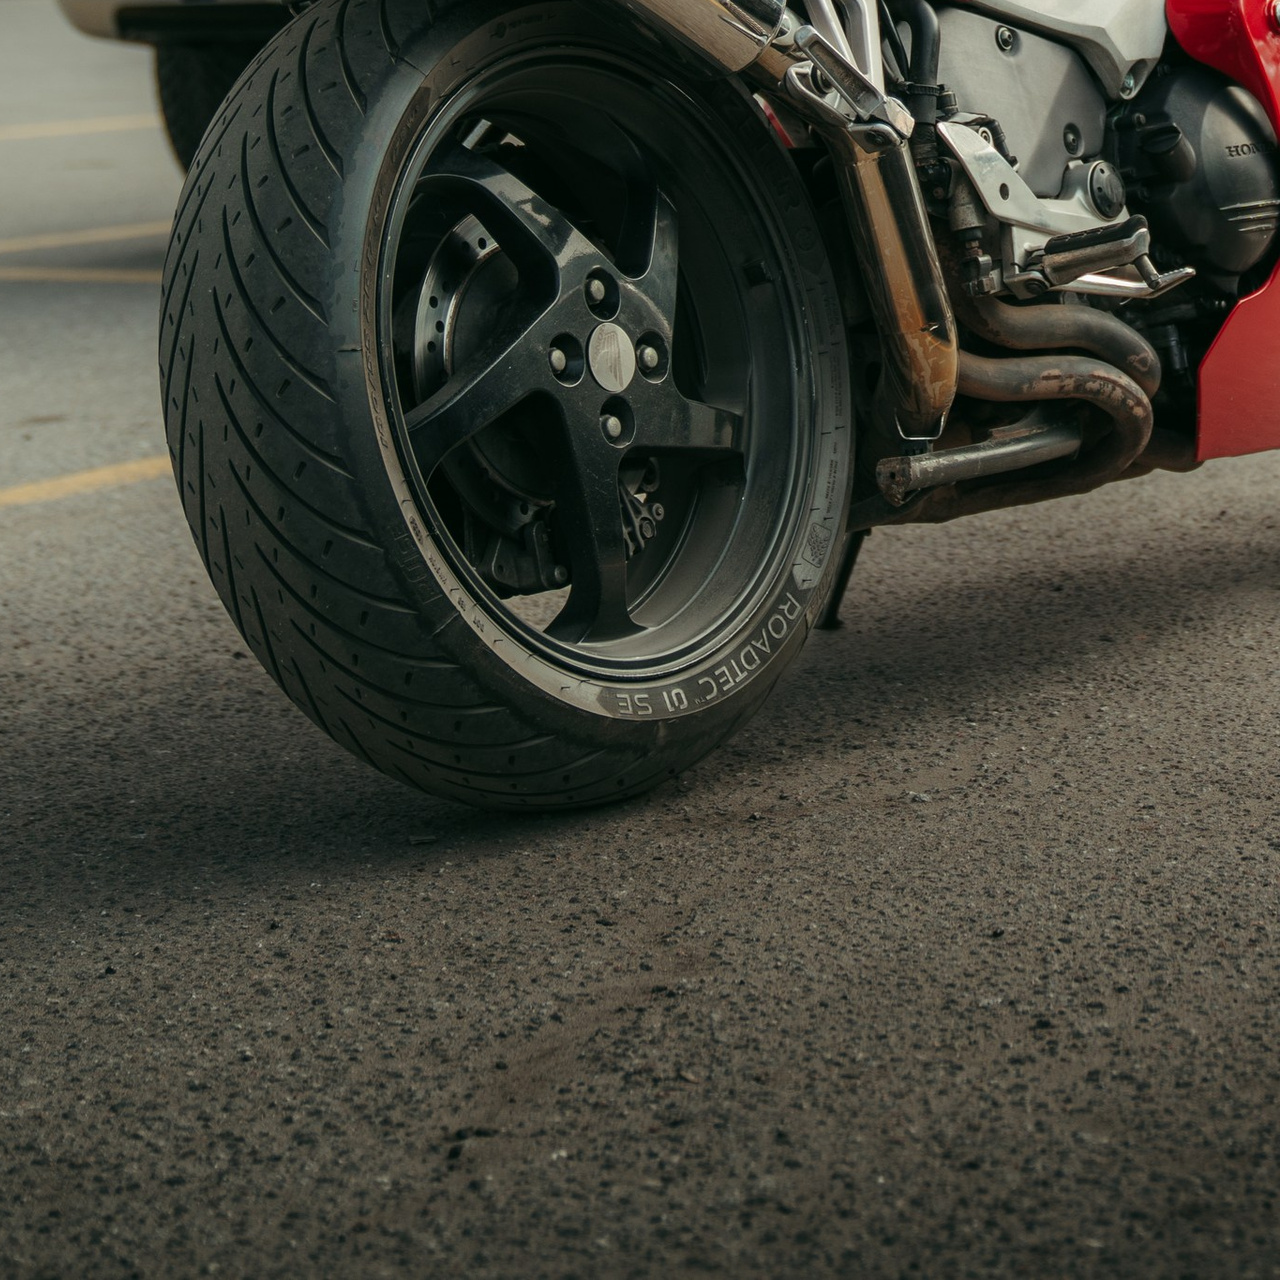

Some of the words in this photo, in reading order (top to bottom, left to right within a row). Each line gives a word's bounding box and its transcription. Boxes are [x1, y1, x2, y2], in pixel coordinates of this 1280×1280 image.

[1225, 142, 1270, 158] HON
[615, 693, 653, 716] SE
[661, 687, 688, 713] 01
